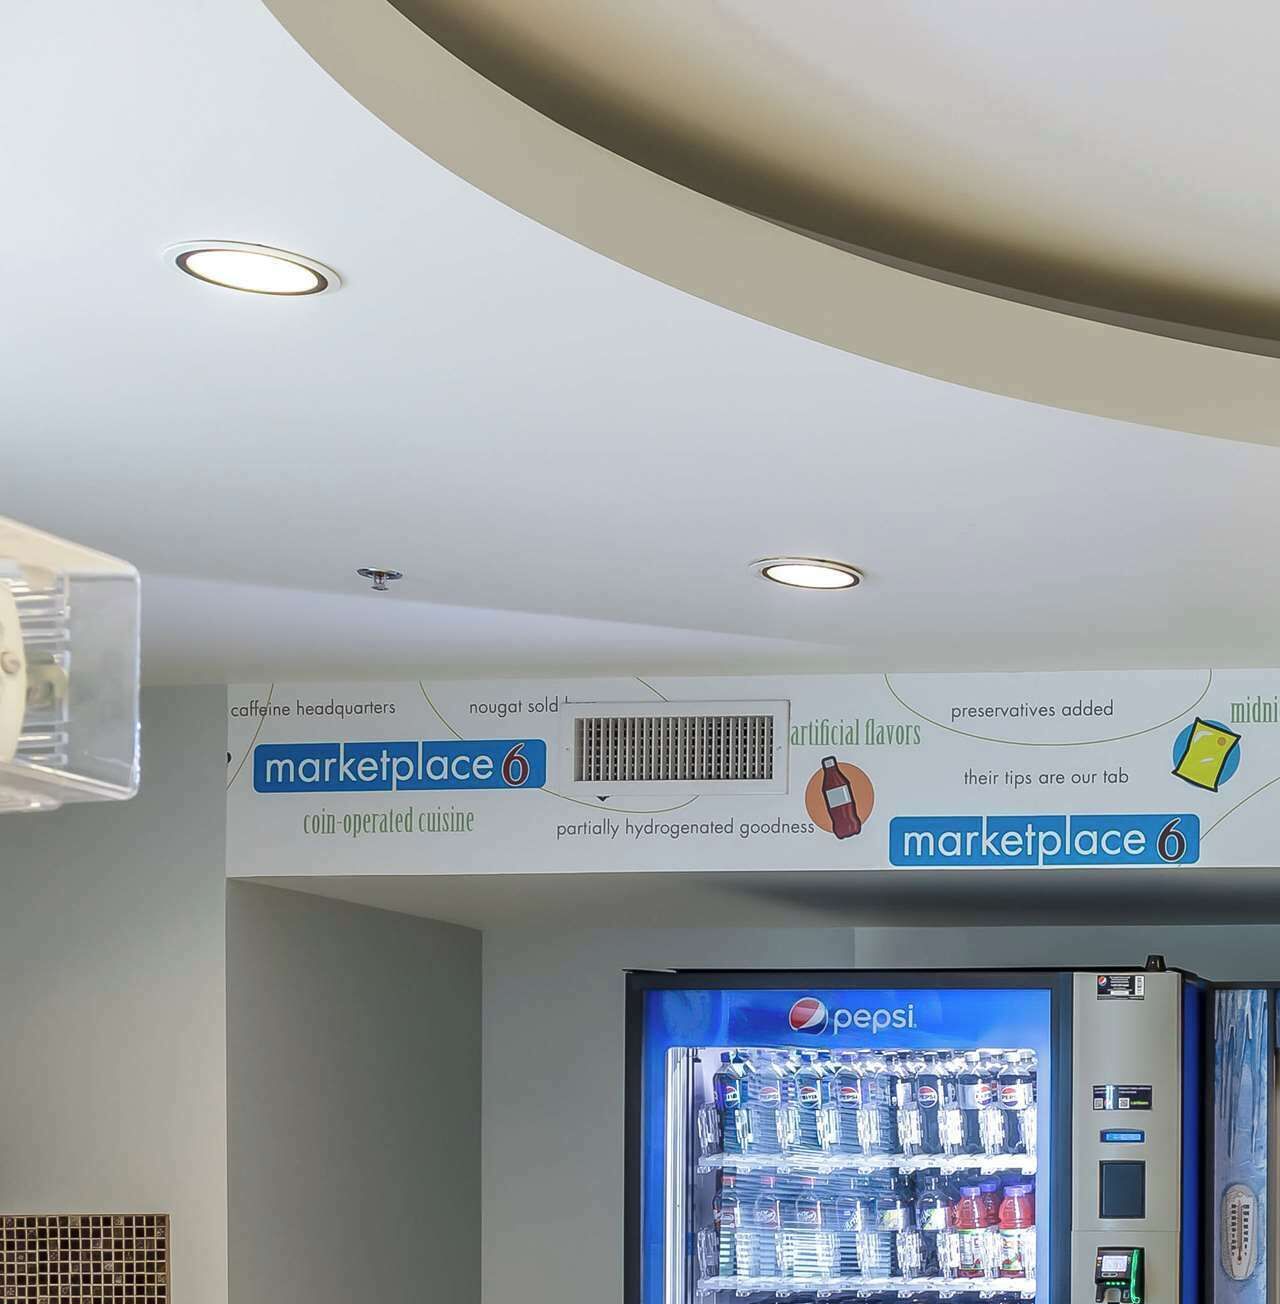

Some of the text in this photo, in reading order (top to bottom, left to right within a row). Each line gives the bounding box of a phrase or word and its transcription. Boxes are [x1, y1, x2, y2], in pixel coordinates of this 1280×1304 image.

[230, 699, 396, 719] caffeine headquarters
[469, 696, 558, 717] nougat sold
[951, 699, 1114, 722] preservatives added
[790, 717, 921, 746] artificial flavors
[265, 743, 530, 791] marketplace 6
[964, 767, 1129, 789] their tips are our tab
[303, 806, 475, 838] coin-operated cuisine
[556, 815, 815, 840] partially hydrogenated goodness
[903, 816, 1187, 864] marketplace 6
[833, 1003, 917, 1035] pepsi
